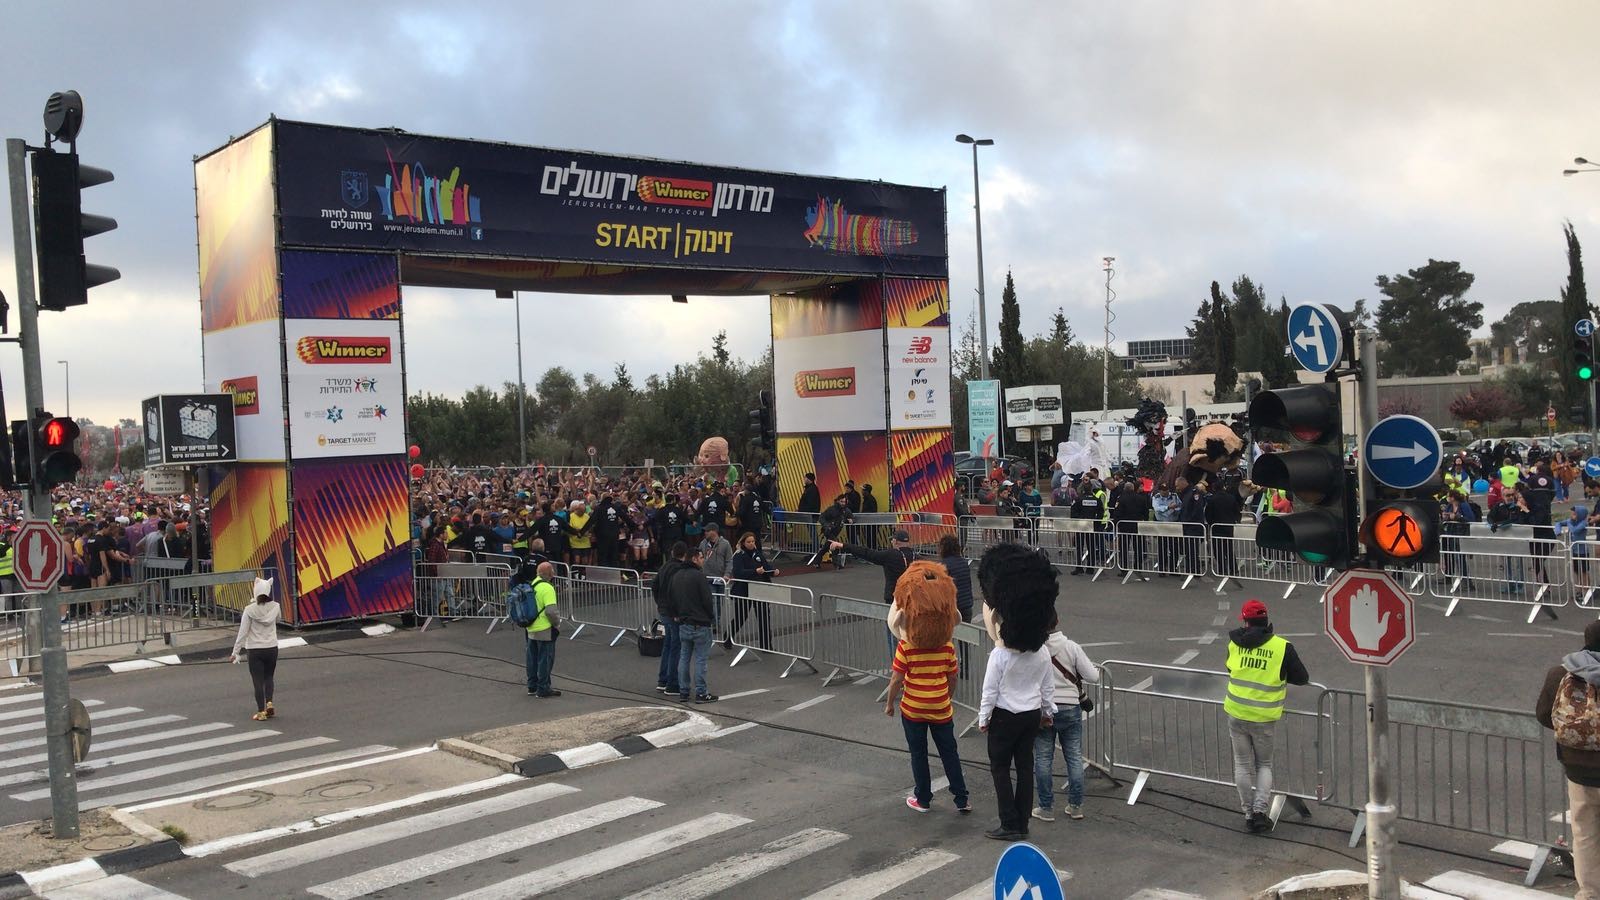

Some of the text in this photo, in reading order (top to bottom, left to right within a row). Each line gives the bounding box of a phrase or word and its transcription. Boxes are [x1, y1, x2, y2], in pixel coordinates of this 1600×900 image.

[540, 161, 775, 217] מרתון Winner ירושלים
[321, 208, 373, 220] שווה לחיות
[330, 219, 373, 231] בירושלים
[383, 223, 464, 236] www.jerusalem.muni.il
[595, 222, 672, 250] START
[684, 228, 734, 256] זינוק
[317, 339, 387, 358] Winner
[914, 356, 938, 364] balance
[805, 373, 852, 391] Winner
[320, 386, 352, 394] התיירות
[1256, 648, 1274, 659] צוות
[1240, 656, 1268, 670] בטחון
